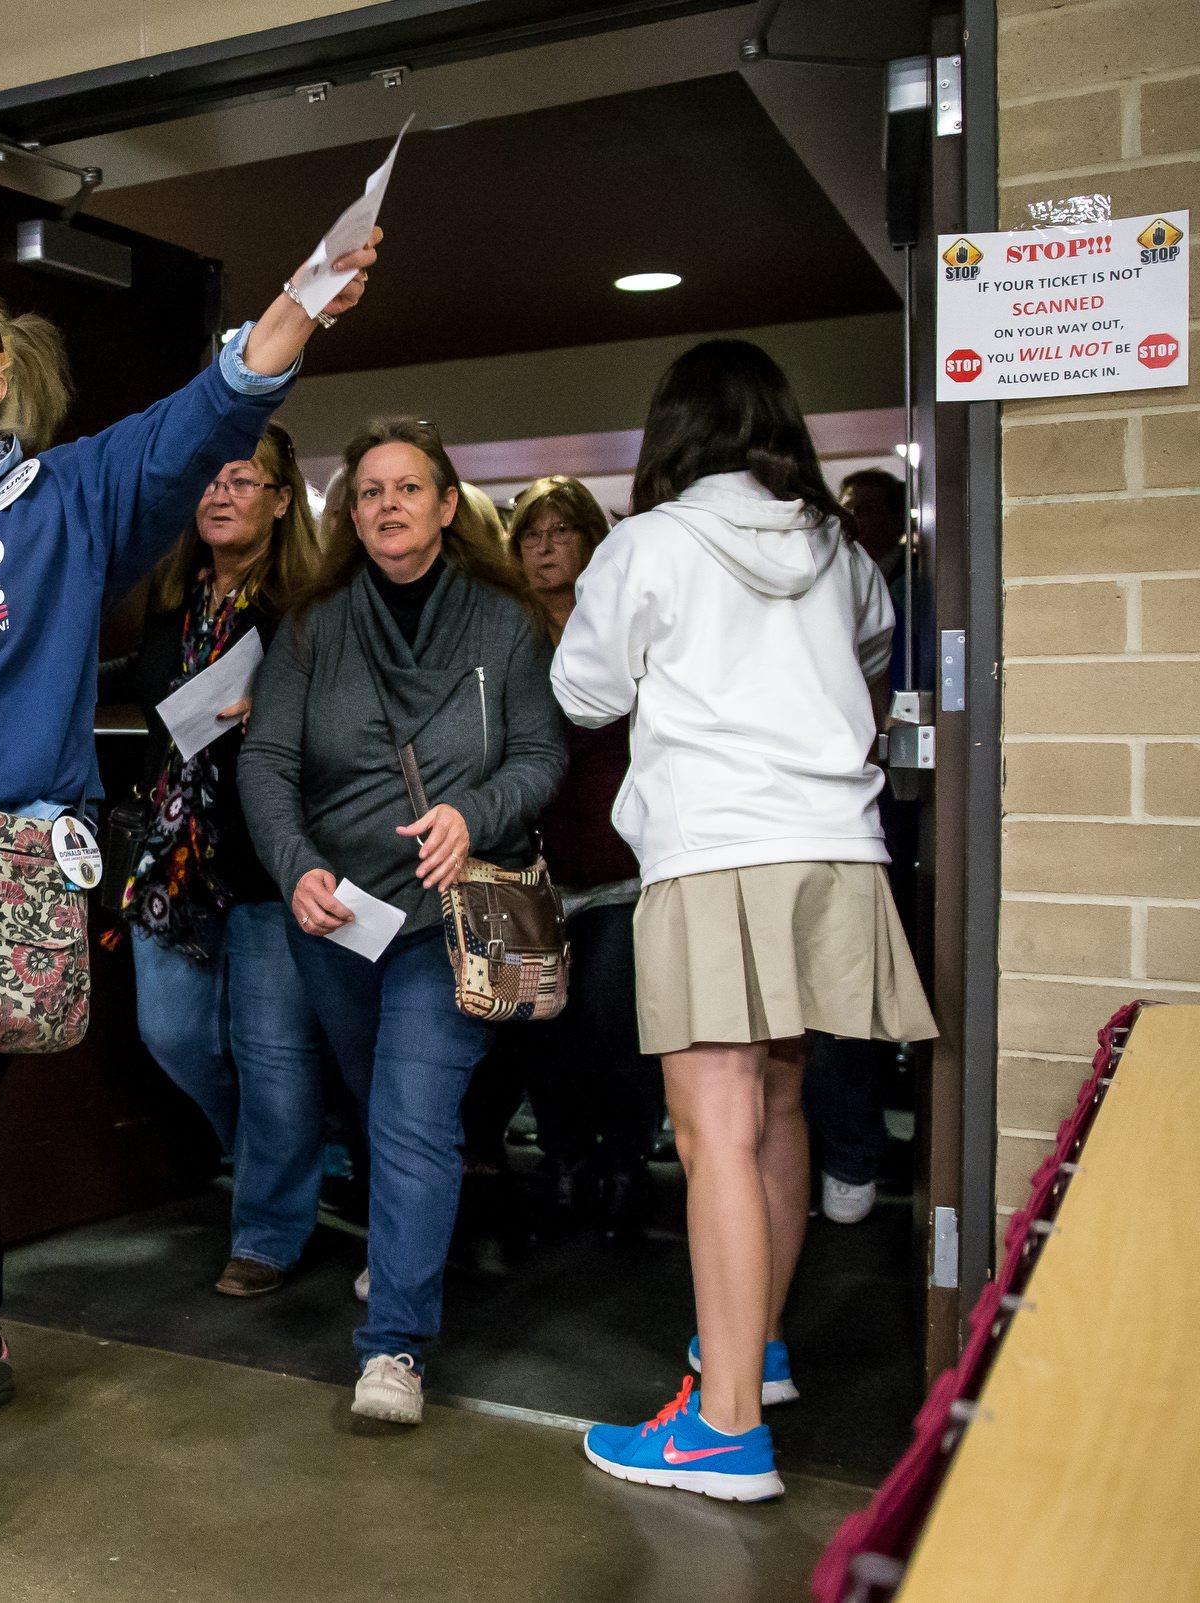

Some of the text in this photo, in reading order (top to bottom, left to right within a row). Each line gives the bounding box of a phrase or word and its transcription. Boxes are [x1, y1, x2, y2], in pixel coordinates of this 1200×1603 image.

[1006, 235, 1112, 264] STOP!!!
[1140, 245, 1180, 265] STOP
[945, 266, 980, 281] STOP
[978, 267, 1143, 293] IF YOUR TICKET IS NOT
[1012, 295, 1105, 317] SCANNED
[994, 319, 1124, 339] ON YOUR WAY OUT,
[987, 341, 1131, 364] YOU WILL NOT BE
[1138, 343, 1178, 359] STOP
[946, 359, 981, 373] STOP
[997, 366, 1120, 385] ALLOWED BACK IN.
